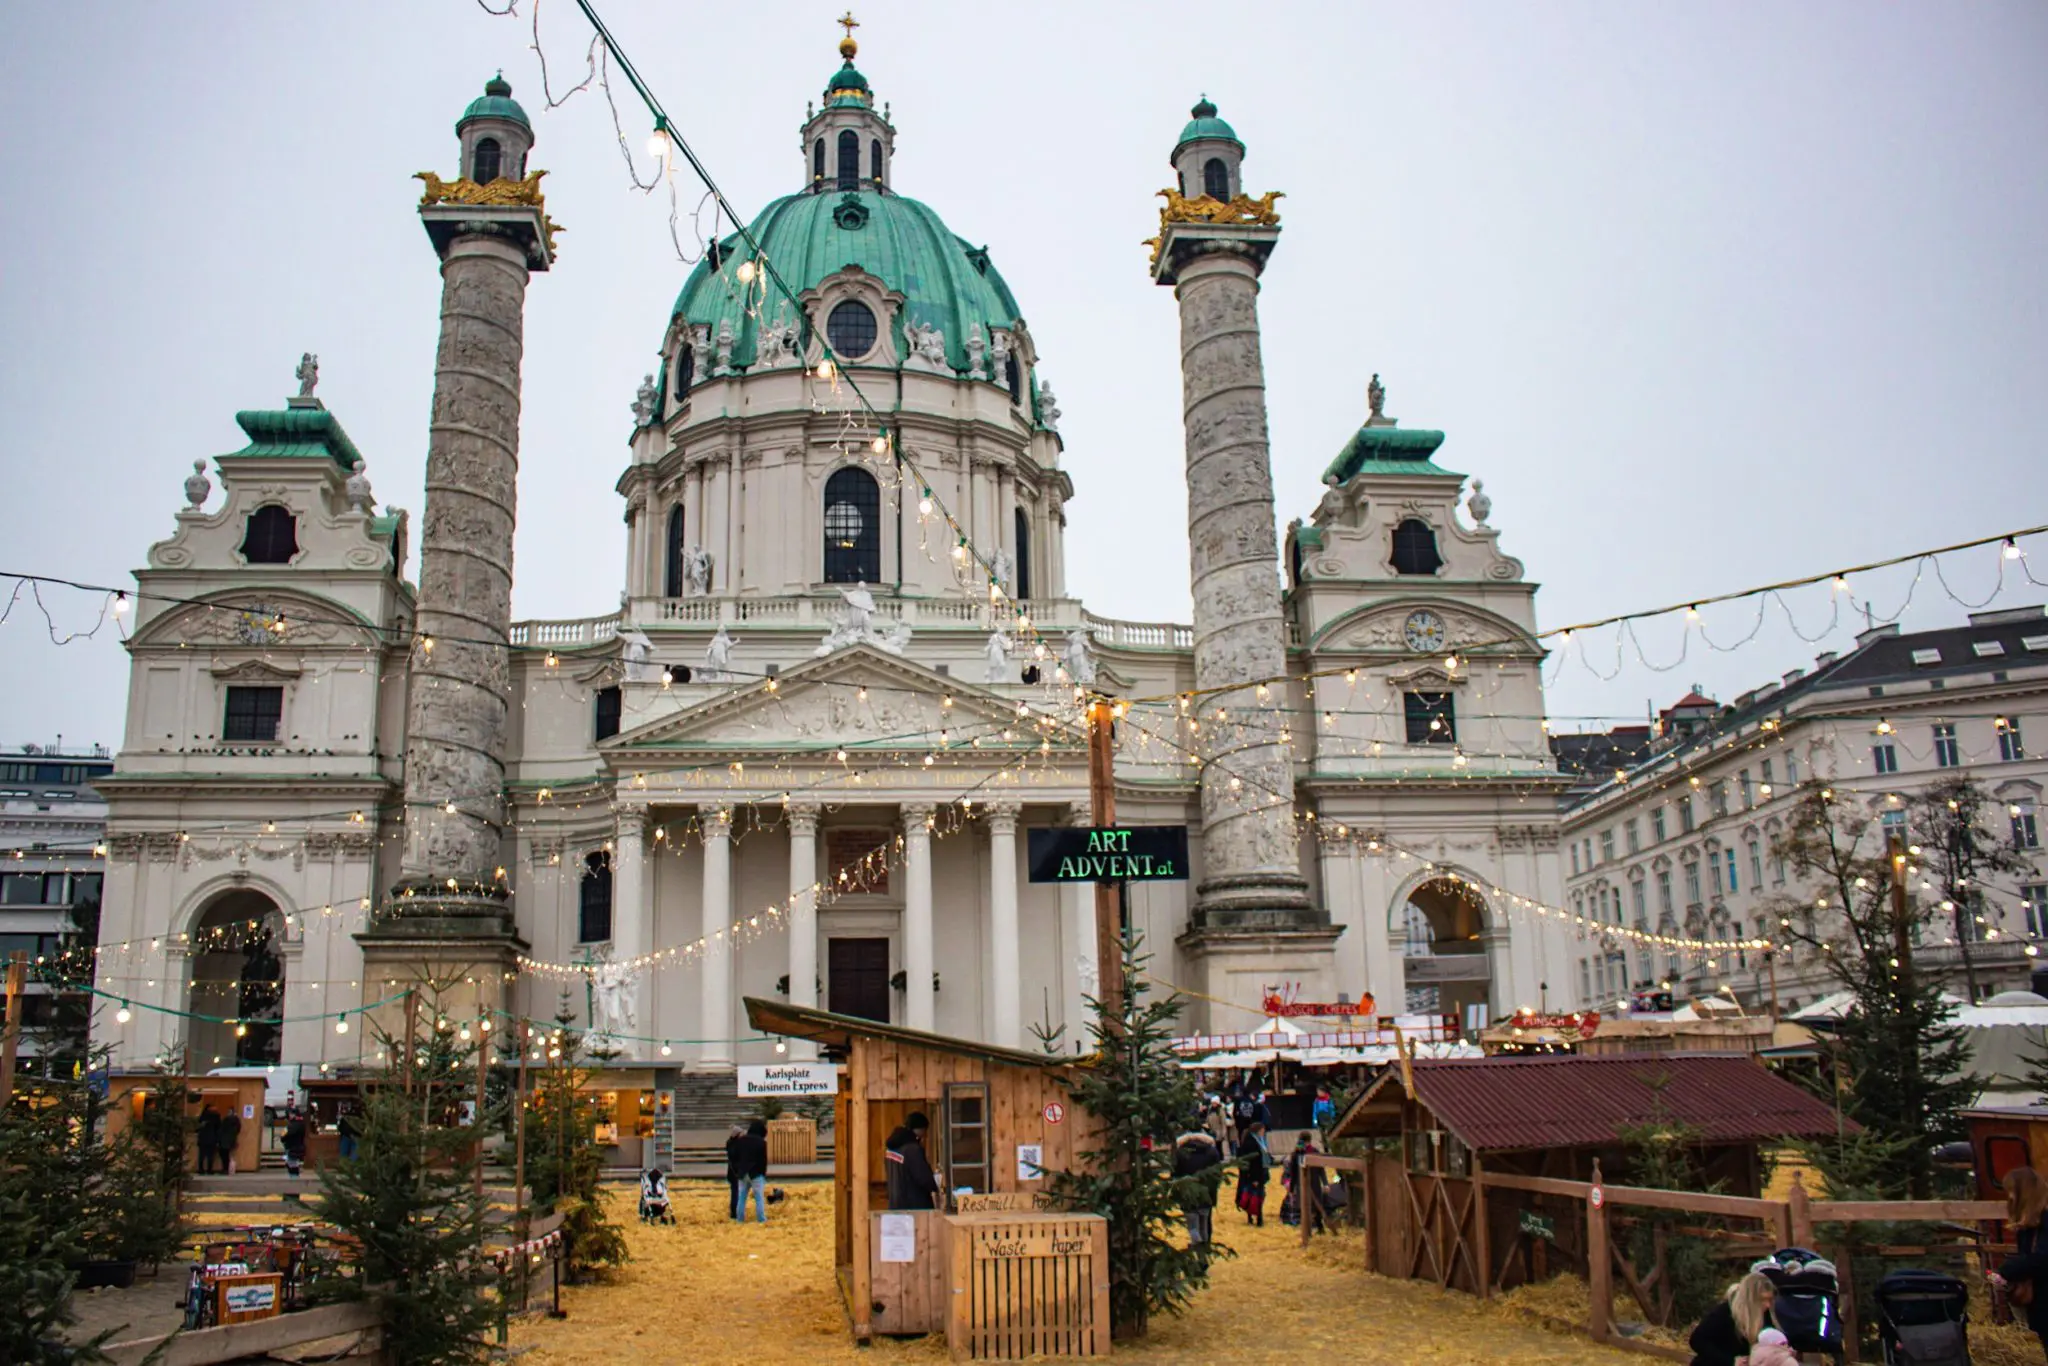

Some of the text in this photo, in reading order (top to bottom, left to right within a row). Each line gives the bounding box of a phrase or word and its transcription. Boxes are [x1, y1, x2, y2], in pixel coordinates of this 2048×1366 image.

[1087, 831, 1131, 852] ART
[1057, 855, 1175, 877] ADVENT.at
[1523, 1015, 1565, 1026] PUNSCH
[765, 1068, 810, 1081] Karlsplatz
[747, 1080, 828, 1093] Draisinen Express
[985, 1237, 1085, 1256] Waste Paper
